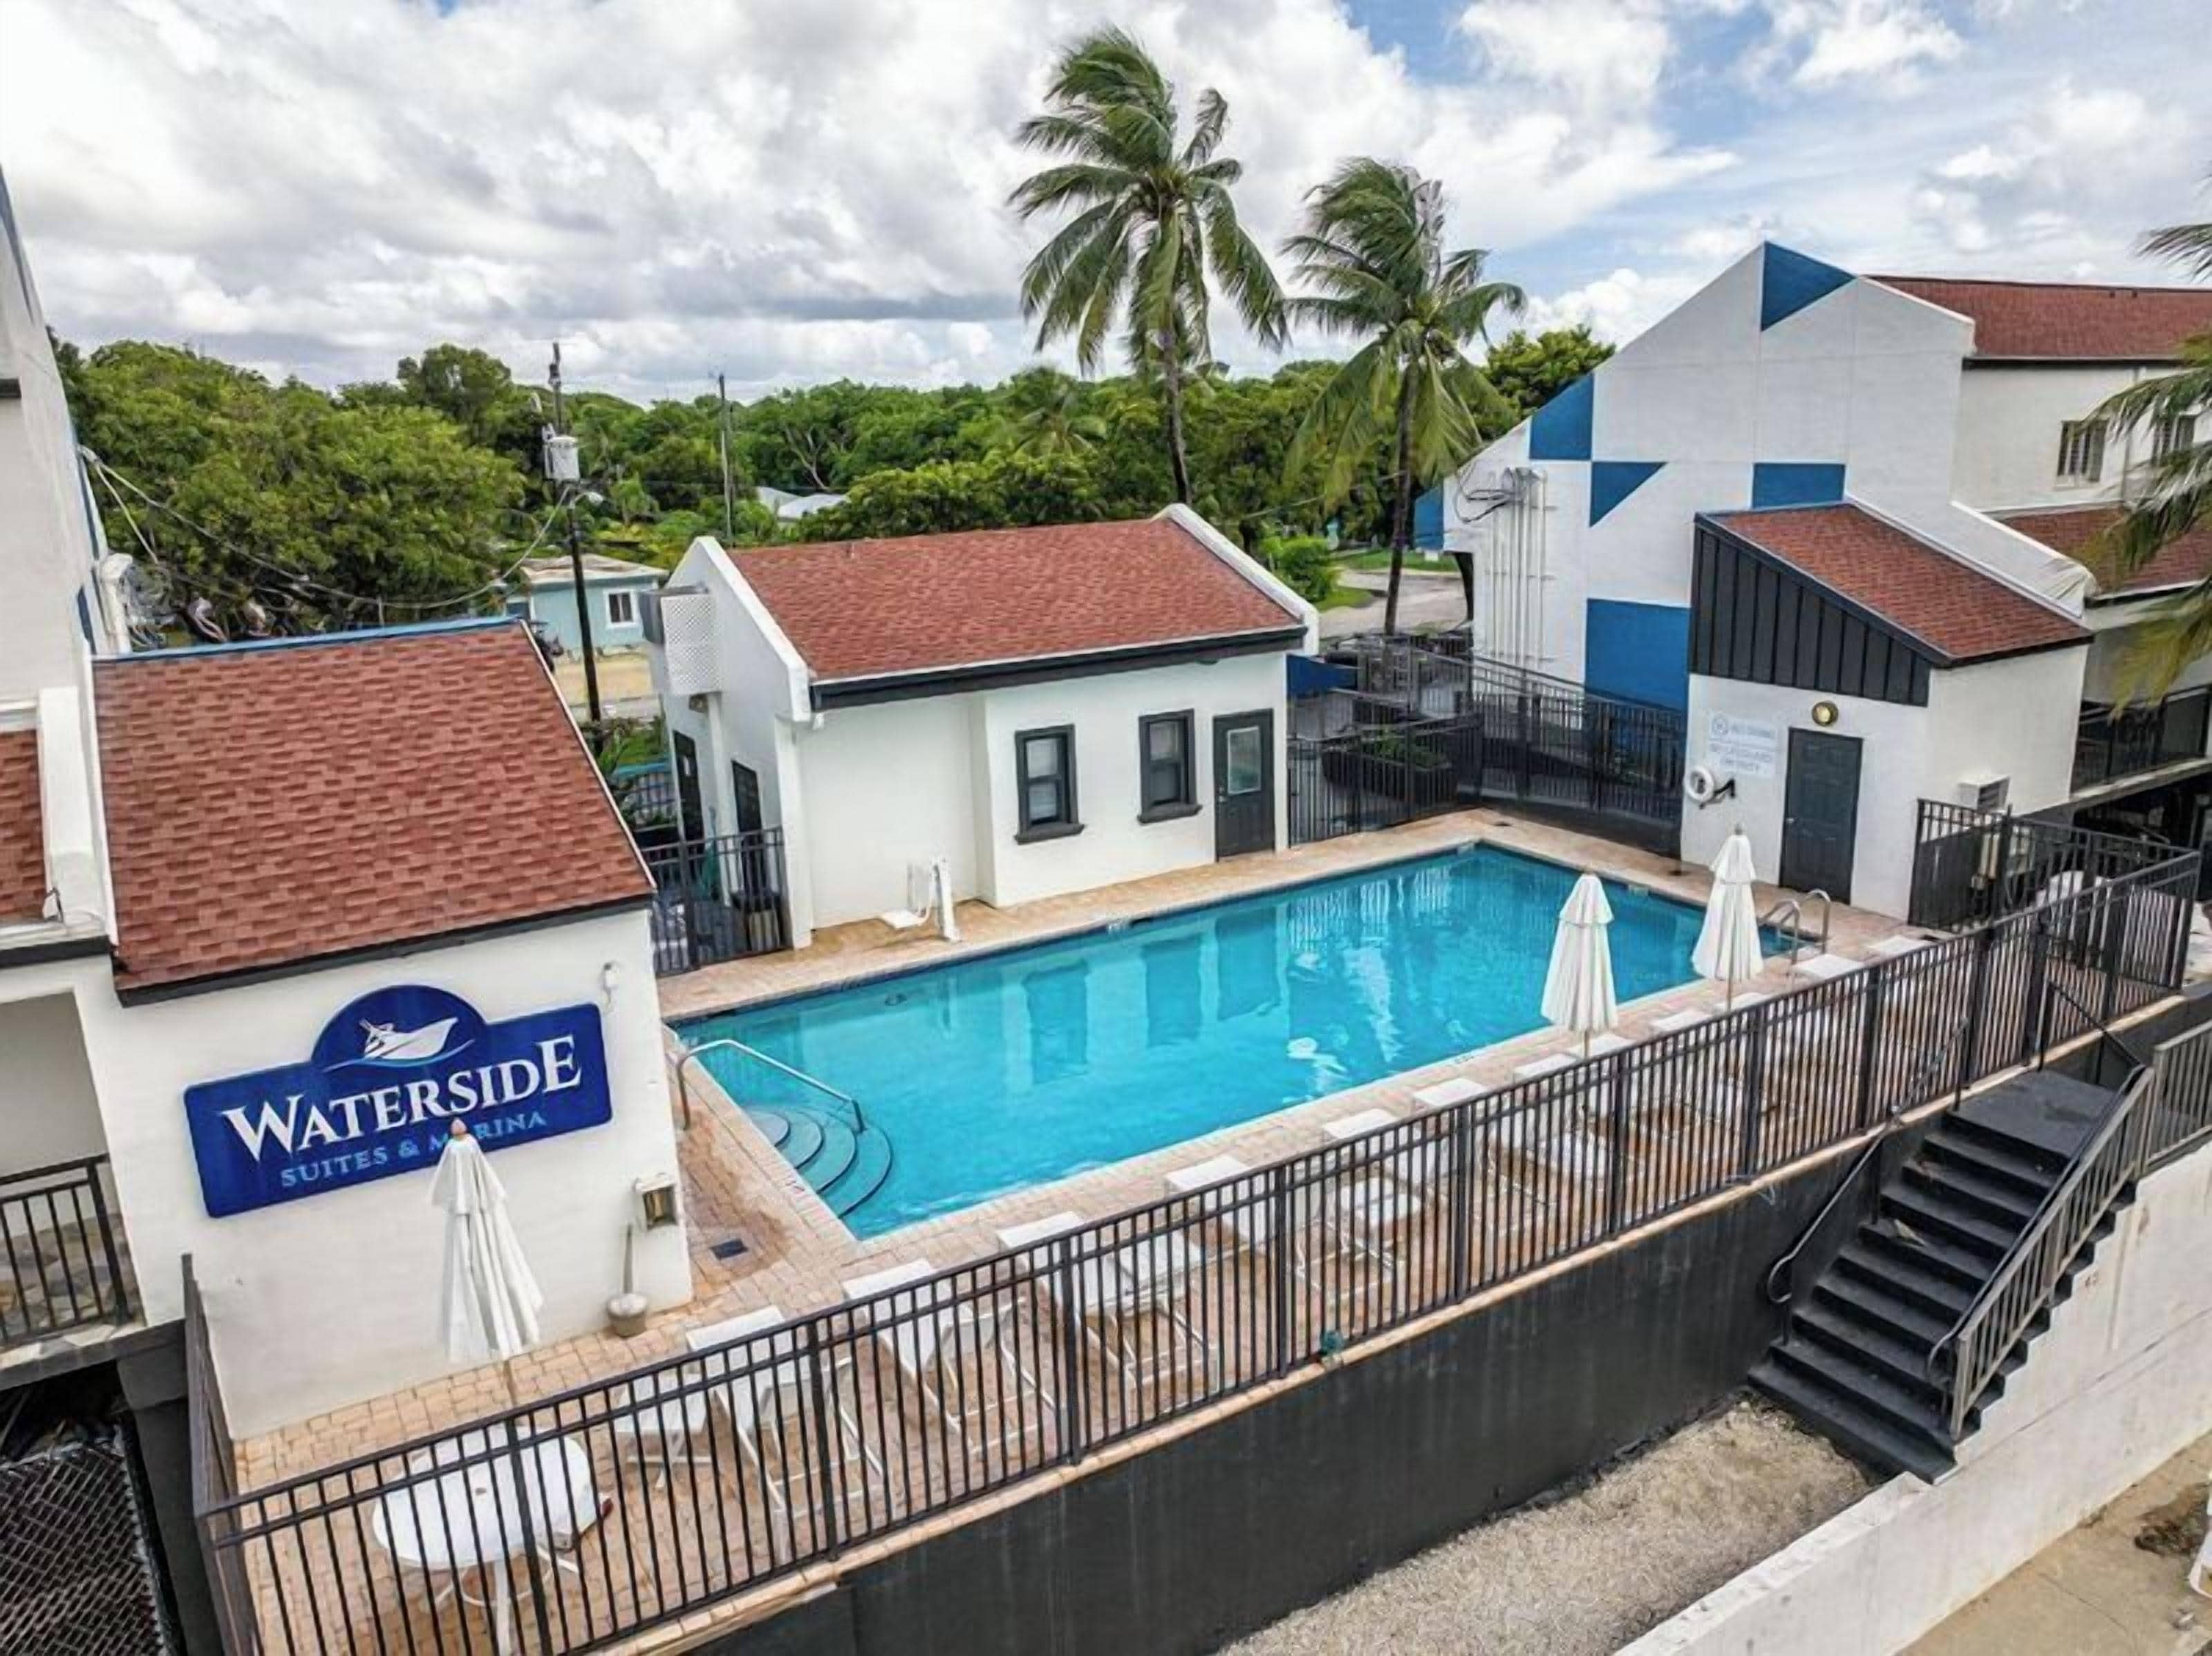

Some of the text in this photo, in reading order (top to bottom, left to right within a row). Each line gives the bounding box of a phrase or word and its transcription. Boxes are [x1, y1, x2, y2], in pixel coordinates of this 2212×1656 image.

[223, 1035, 582, 1165] WATERSIDE
[281, 1111, 547, 1187] SUITES & MRINA
